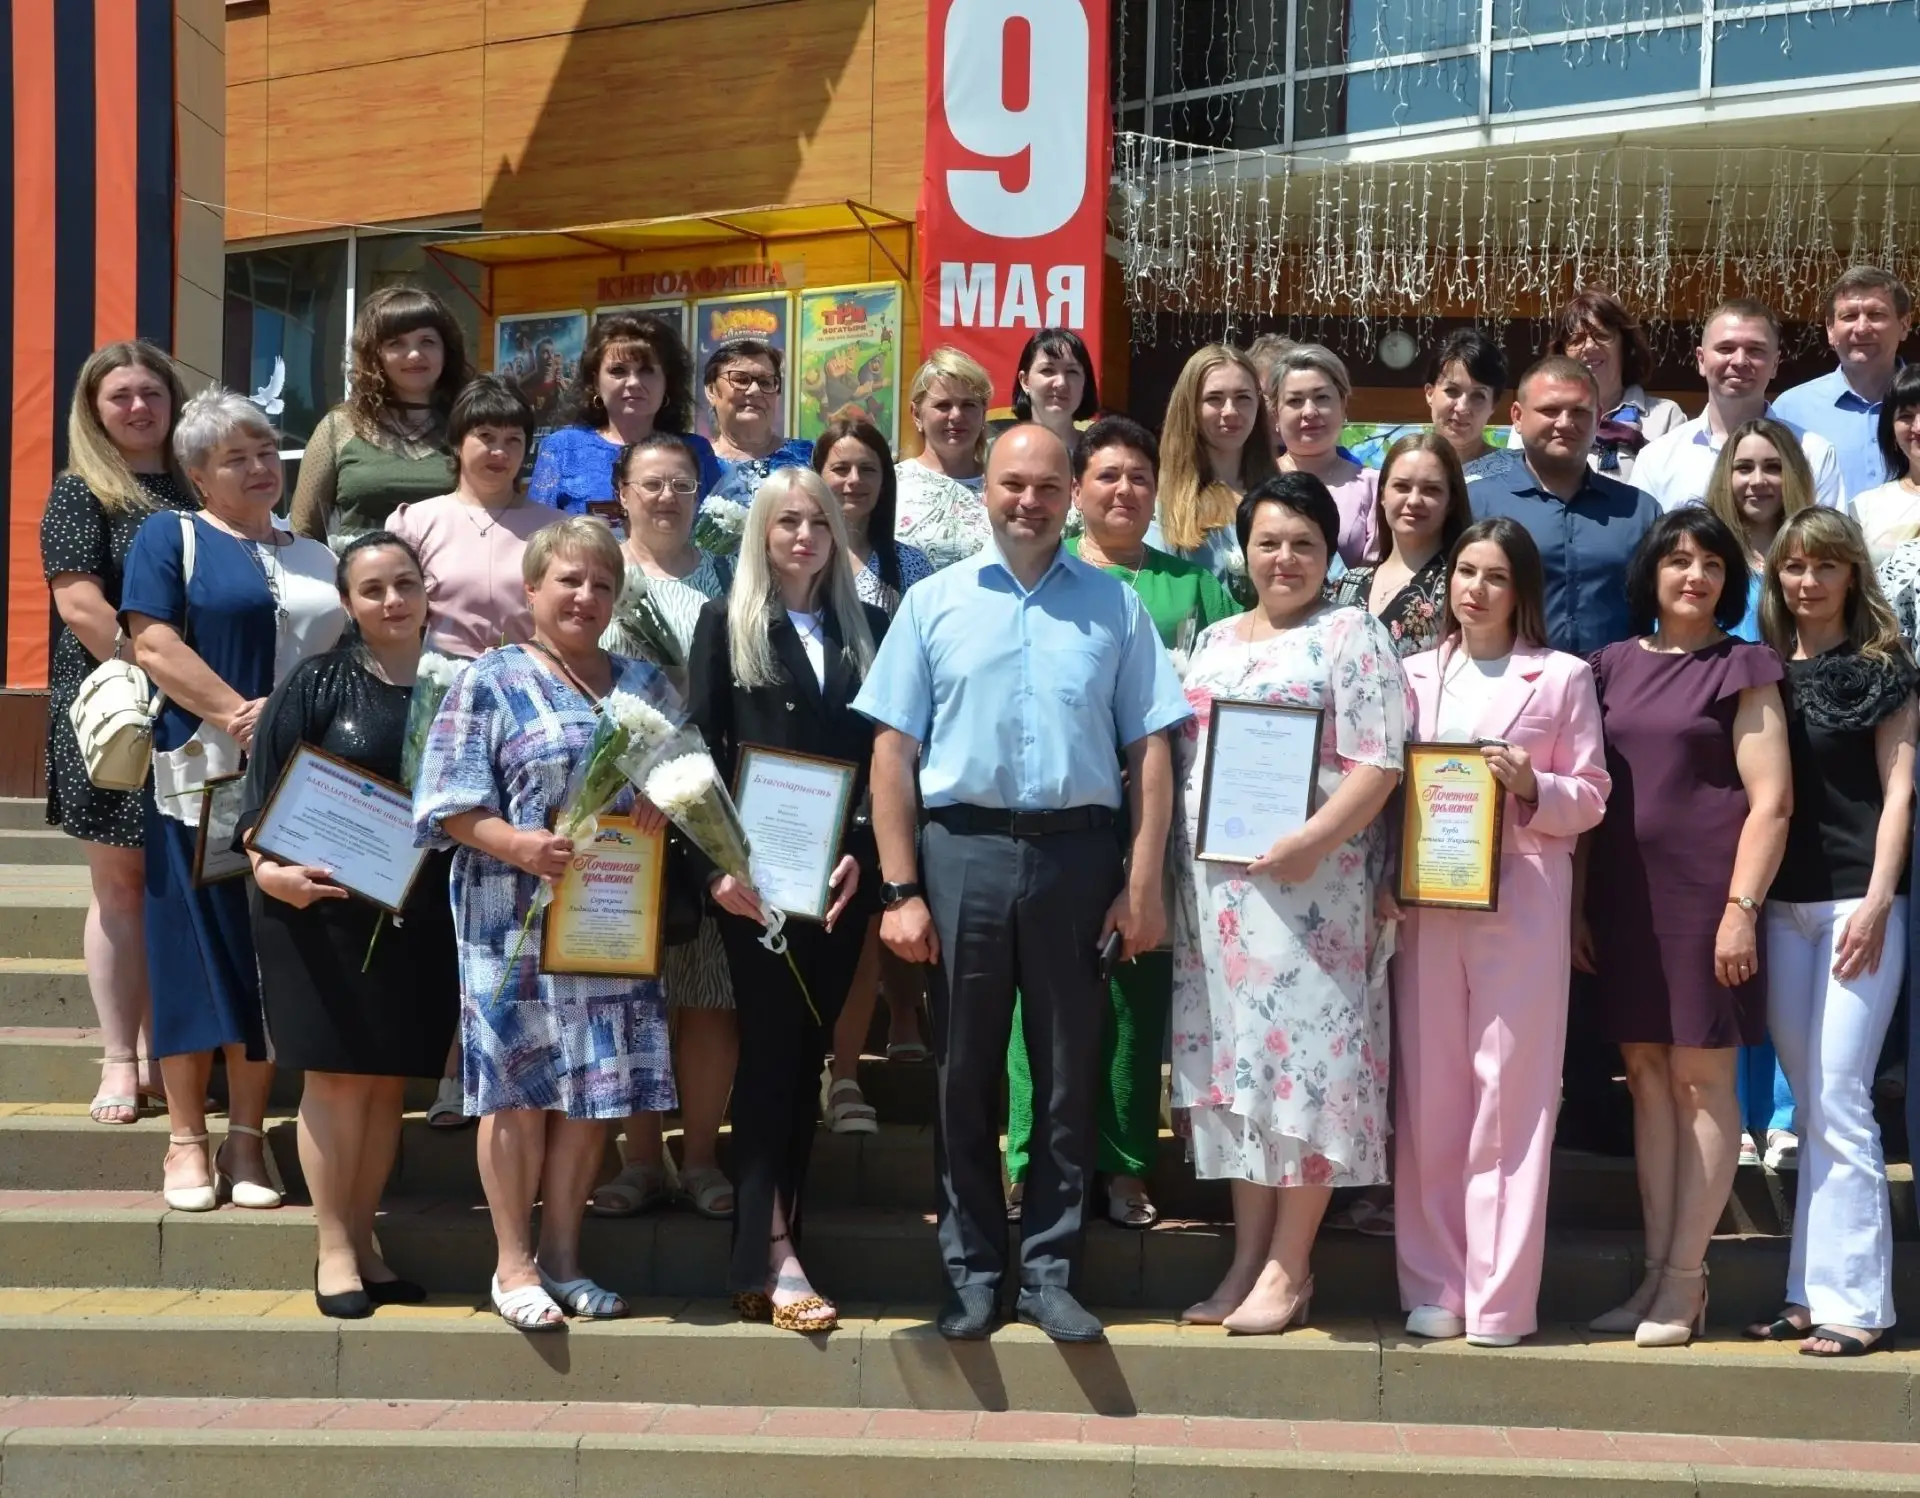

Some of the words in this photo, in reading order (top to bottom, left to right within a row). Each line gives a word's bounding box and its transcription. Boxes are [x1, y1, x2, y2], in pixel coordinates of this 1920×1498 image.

[943, 0, 1089, 238] 9
[597, 261, 786, 299] КИНОАФИША
[939, 262, 1085, 329] МАЯ
[753, 774, 831, 798] Благодарность
